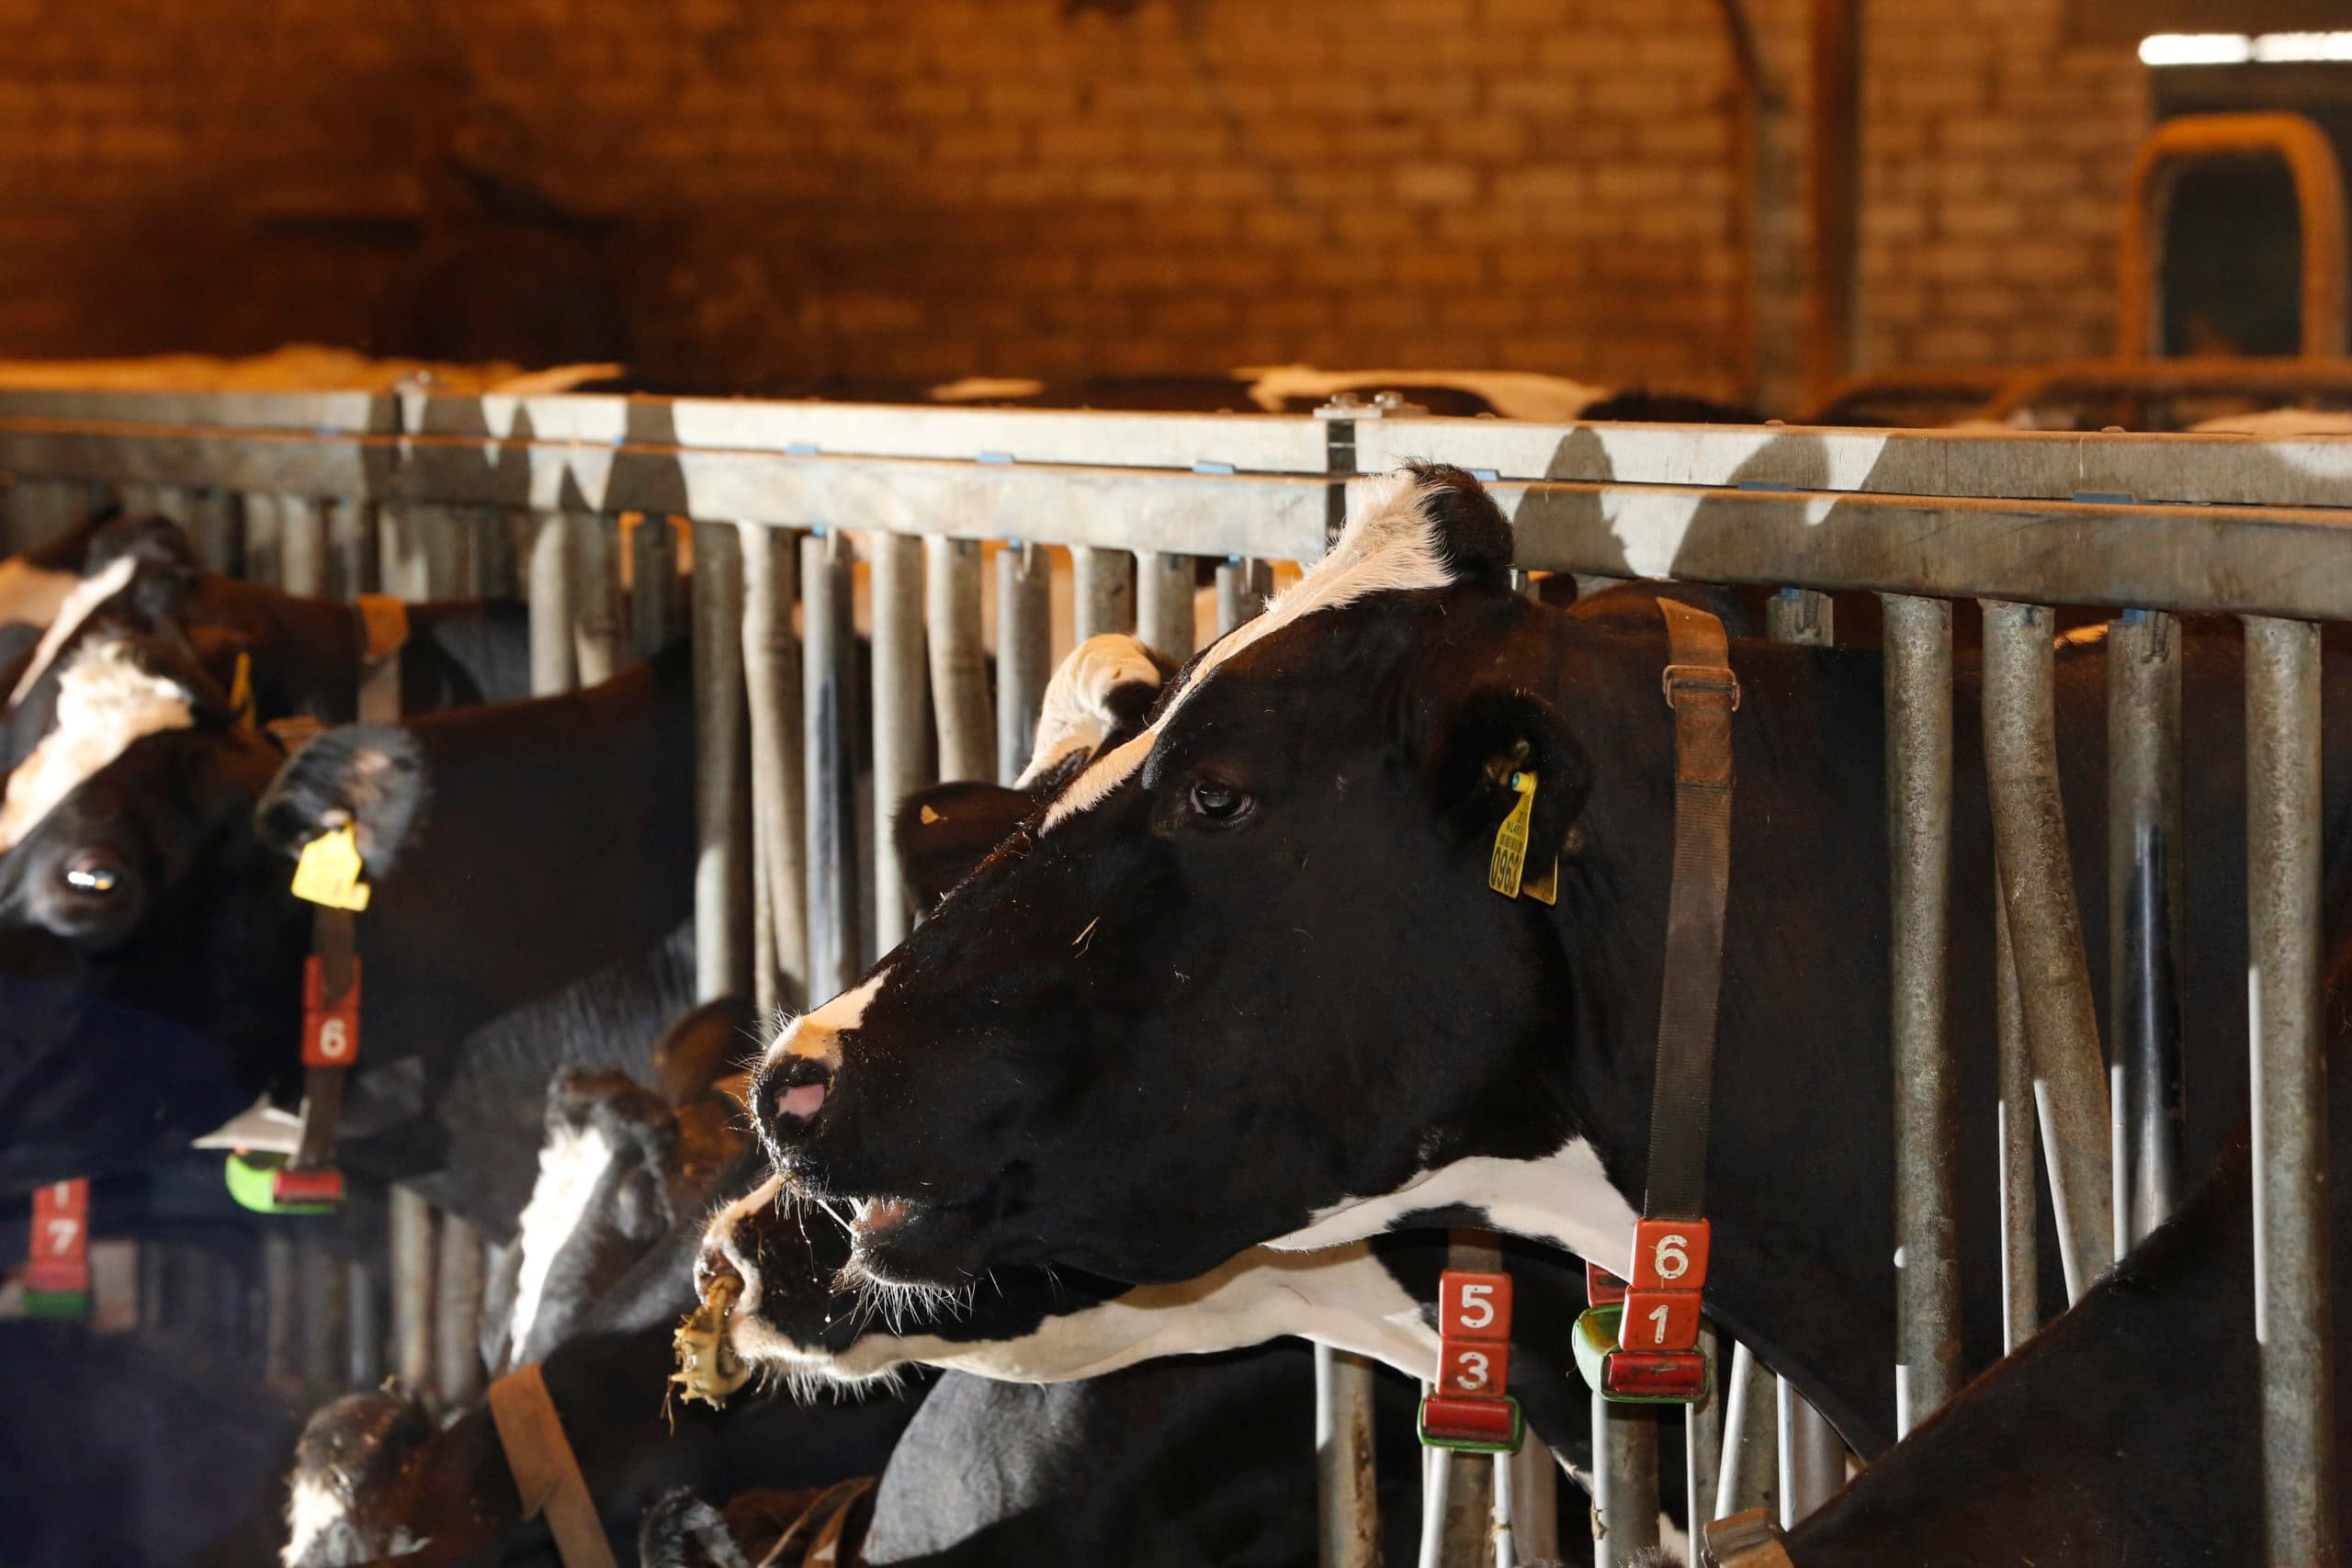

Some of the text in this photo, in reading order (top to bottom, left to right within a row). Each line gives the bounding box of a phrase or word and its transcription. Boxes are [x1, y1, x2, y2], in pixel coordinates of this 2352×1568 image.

[320, 1018, 346, 1057] 6
[49, 1220, 78, 1256] 7
[1655, 1235, 1689, 1279] 6
[1461, 1285, 1494, 1328] 5
[1649, 1304, 1668, 1344] 1
[1456, 1352, 1488, 1390] 3
